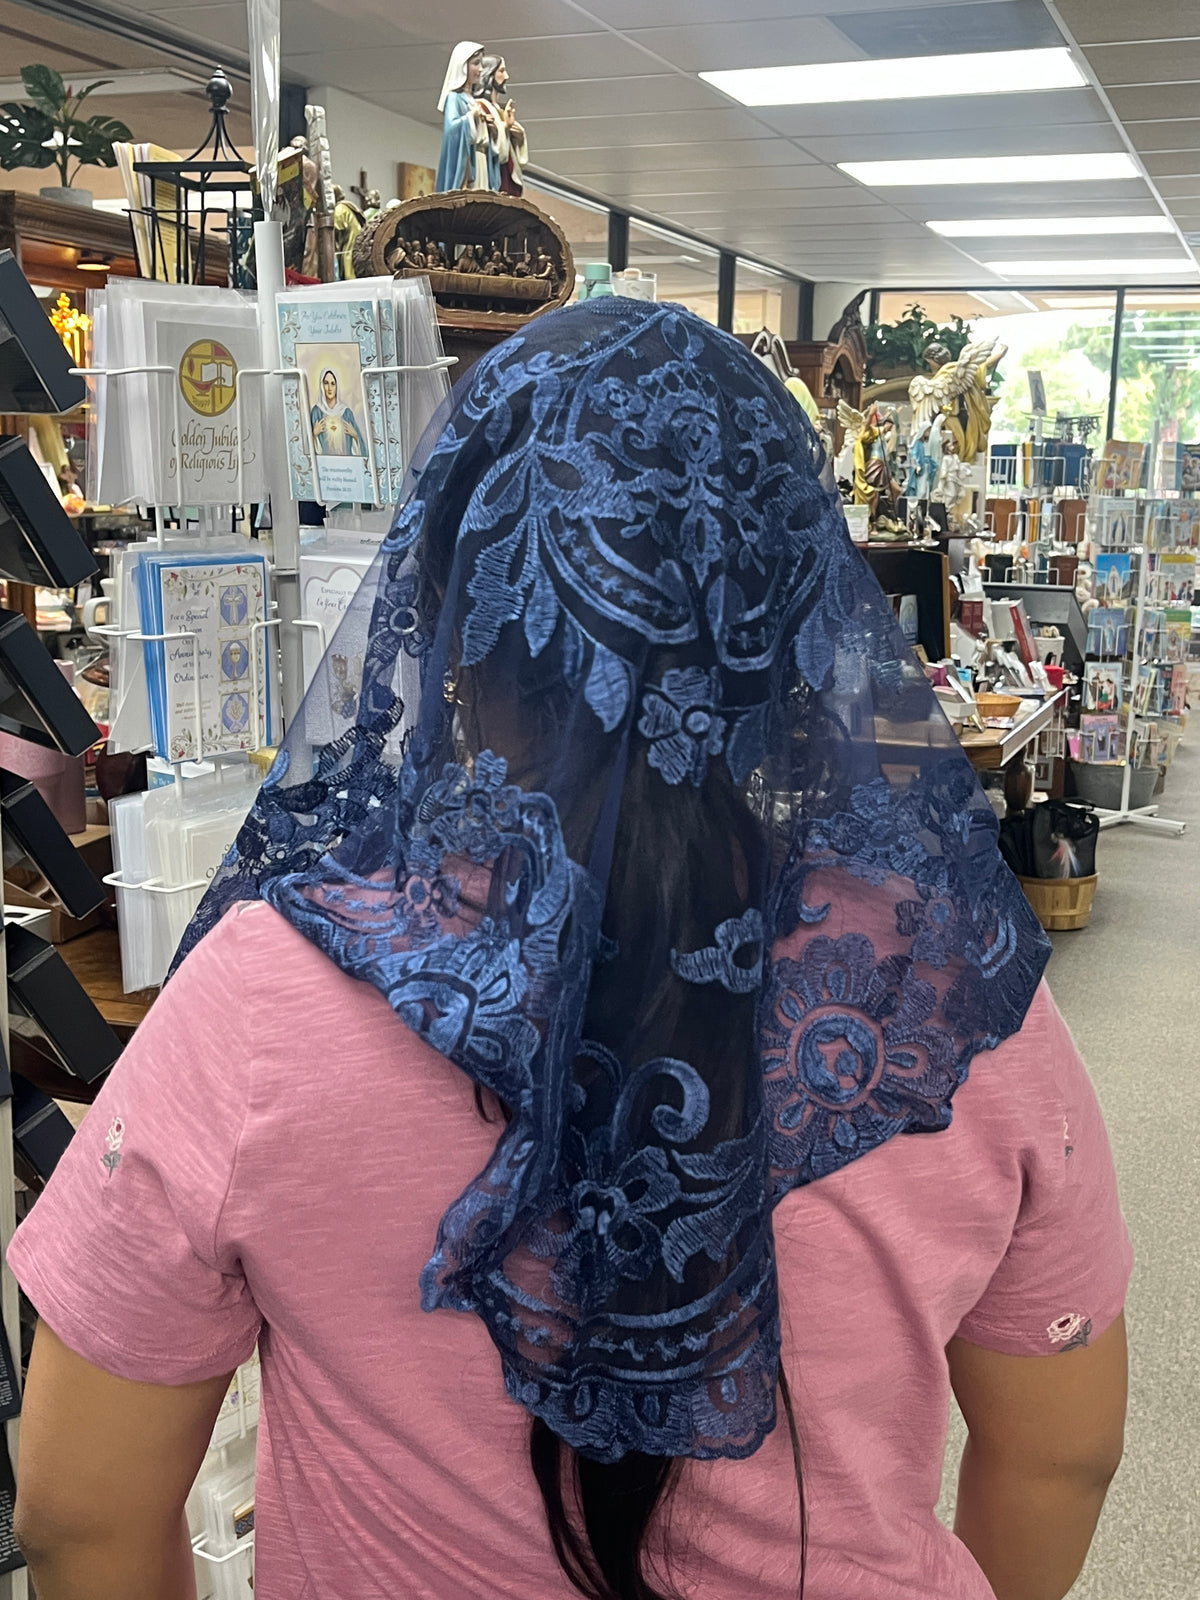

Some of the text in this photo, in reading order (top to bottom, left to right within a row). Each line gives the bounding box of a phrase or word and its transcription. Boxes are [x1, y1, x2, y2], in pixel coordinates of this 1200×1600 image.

[201, 425, 251, 455] Jubile
[181, 449, 225, 482] Religious
[217, 447, 256, 483] Lif
